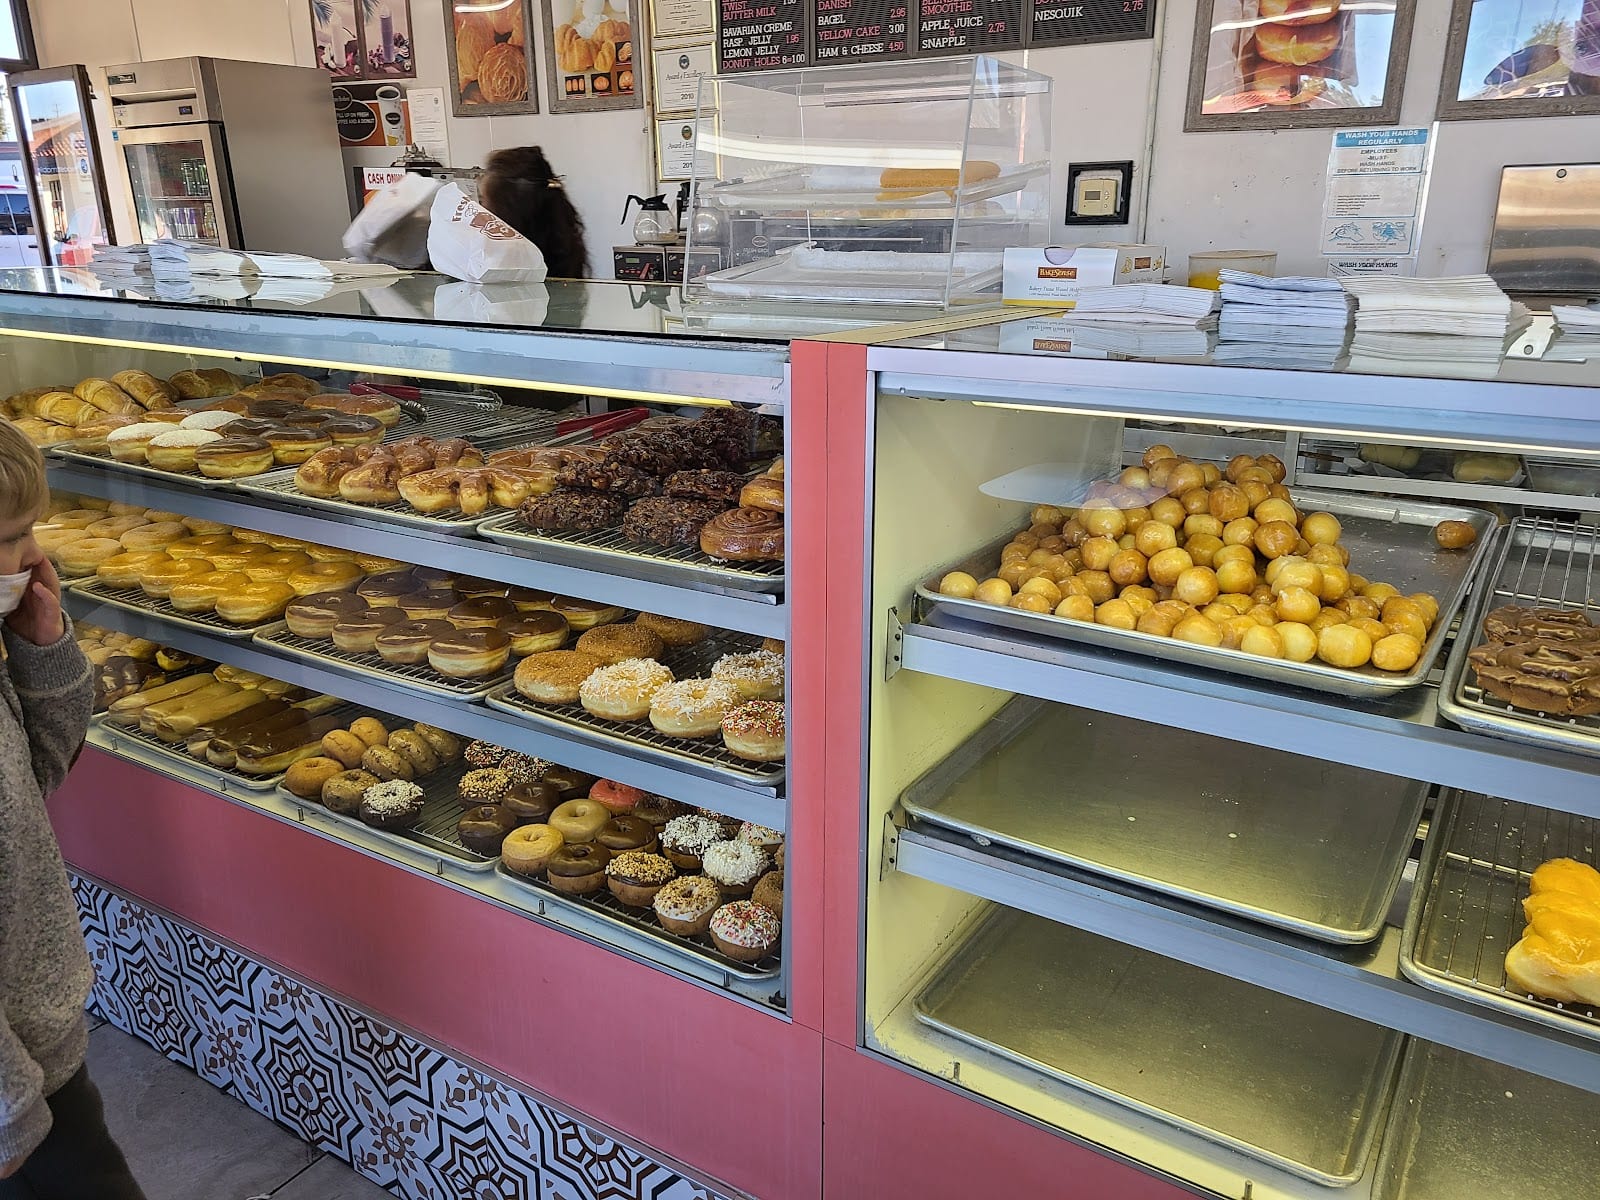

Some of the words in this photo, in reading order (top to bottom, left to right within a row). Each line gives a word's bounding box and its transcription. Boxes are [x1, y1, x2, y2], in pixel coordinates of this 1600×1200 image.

[722, 1, 747, 11] TWIST
[818, 0, 852, 10] DANISH
[922, 1, 972, 15] SMOOTHIE
[1123, 1, 1143, 12] 2.75
[722, 9, 754, 20] BUTTER
[756, 6, 777, 17] MILK
[1034, 7, 1083, 21] NESQUIK
[818, 14, 846, 25] BAGEL
[921, 20, 950, 31] APPLE
[954, 16, 983, 28] JUICE
[722, 25, 762, 37] BAVARIAN
[763, 22, 793, 33] CREME
[818, 29, 853, 40] YELLOW
[856, 26, 881, 37] CAKE
[948, 27, 955, 36] &
[988, 22, 1005, 33] 2.75
[748, 35, 772, 45] JELLY
[922, 36, 966, 48] SNAPPLE
[723, 48, 752, 58] LEMON
[755, 45, 780, 55] JELLY
[818, 47, 838, 57] HAM
[842, 46, 848, 55] &
[850, 43, 884, 54] CHEESE
[722, 59, 751, 69] DONUT
[754, 57, 780, 67] HOLES
[1345, 131, 1367, 139] WASH
[1369, 130, 1389, 138] YOUR
[367, 173, 384, 184] CASH
[387, 173, 403, 184] ON
